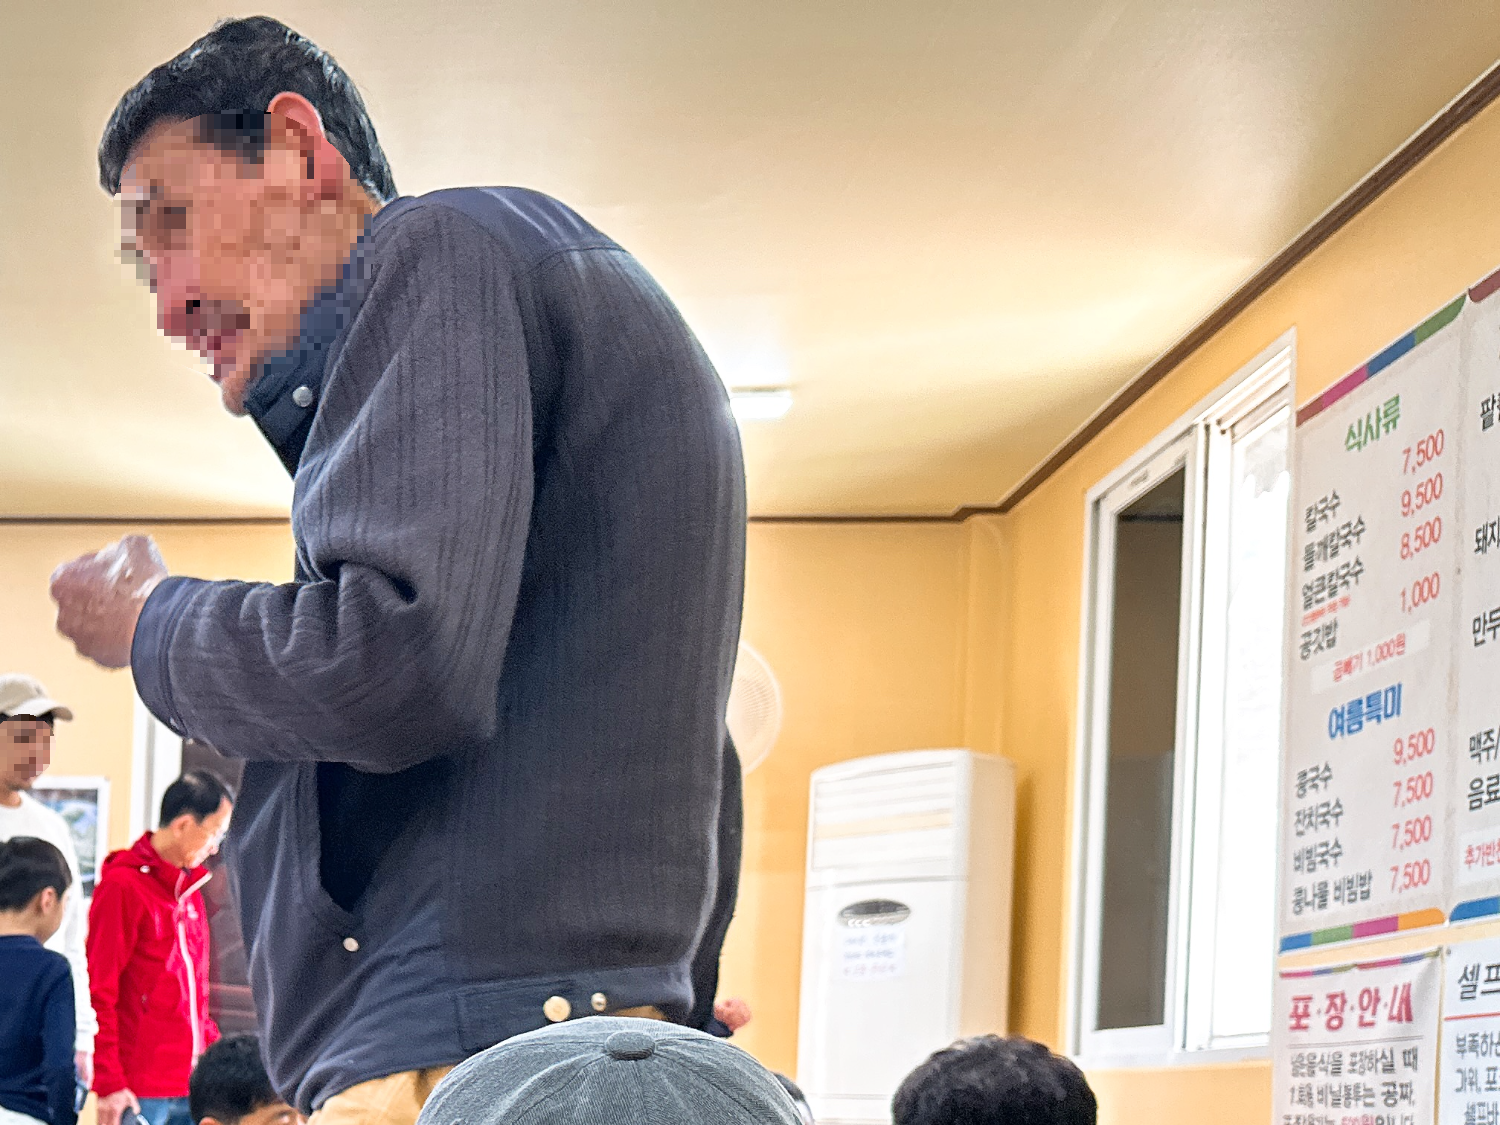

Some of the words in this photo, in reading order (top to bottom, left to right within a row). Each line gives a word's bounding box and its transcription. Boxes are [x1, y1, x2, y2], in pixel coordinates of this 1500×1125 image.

[1345, 394, 1401, 452] 식사류
[1402, 428, 1445, 475] 7,500
[1401, 472, 1443, 518] 9,500
[1400, 515, 1442, 560] 8,500
[1400, 571, 1440, 614] 1,000
[1328, 682, 1402, 740] 여름특미
[1393, 727, 1435, 766] 9,500
[1393, 771, 1433, 808] 7,500
[1392, 814, 1432, 851] 7,500
[1390, 858, 1430, 893] 7,500
[1402, 1045, 1419, 1073] 때
